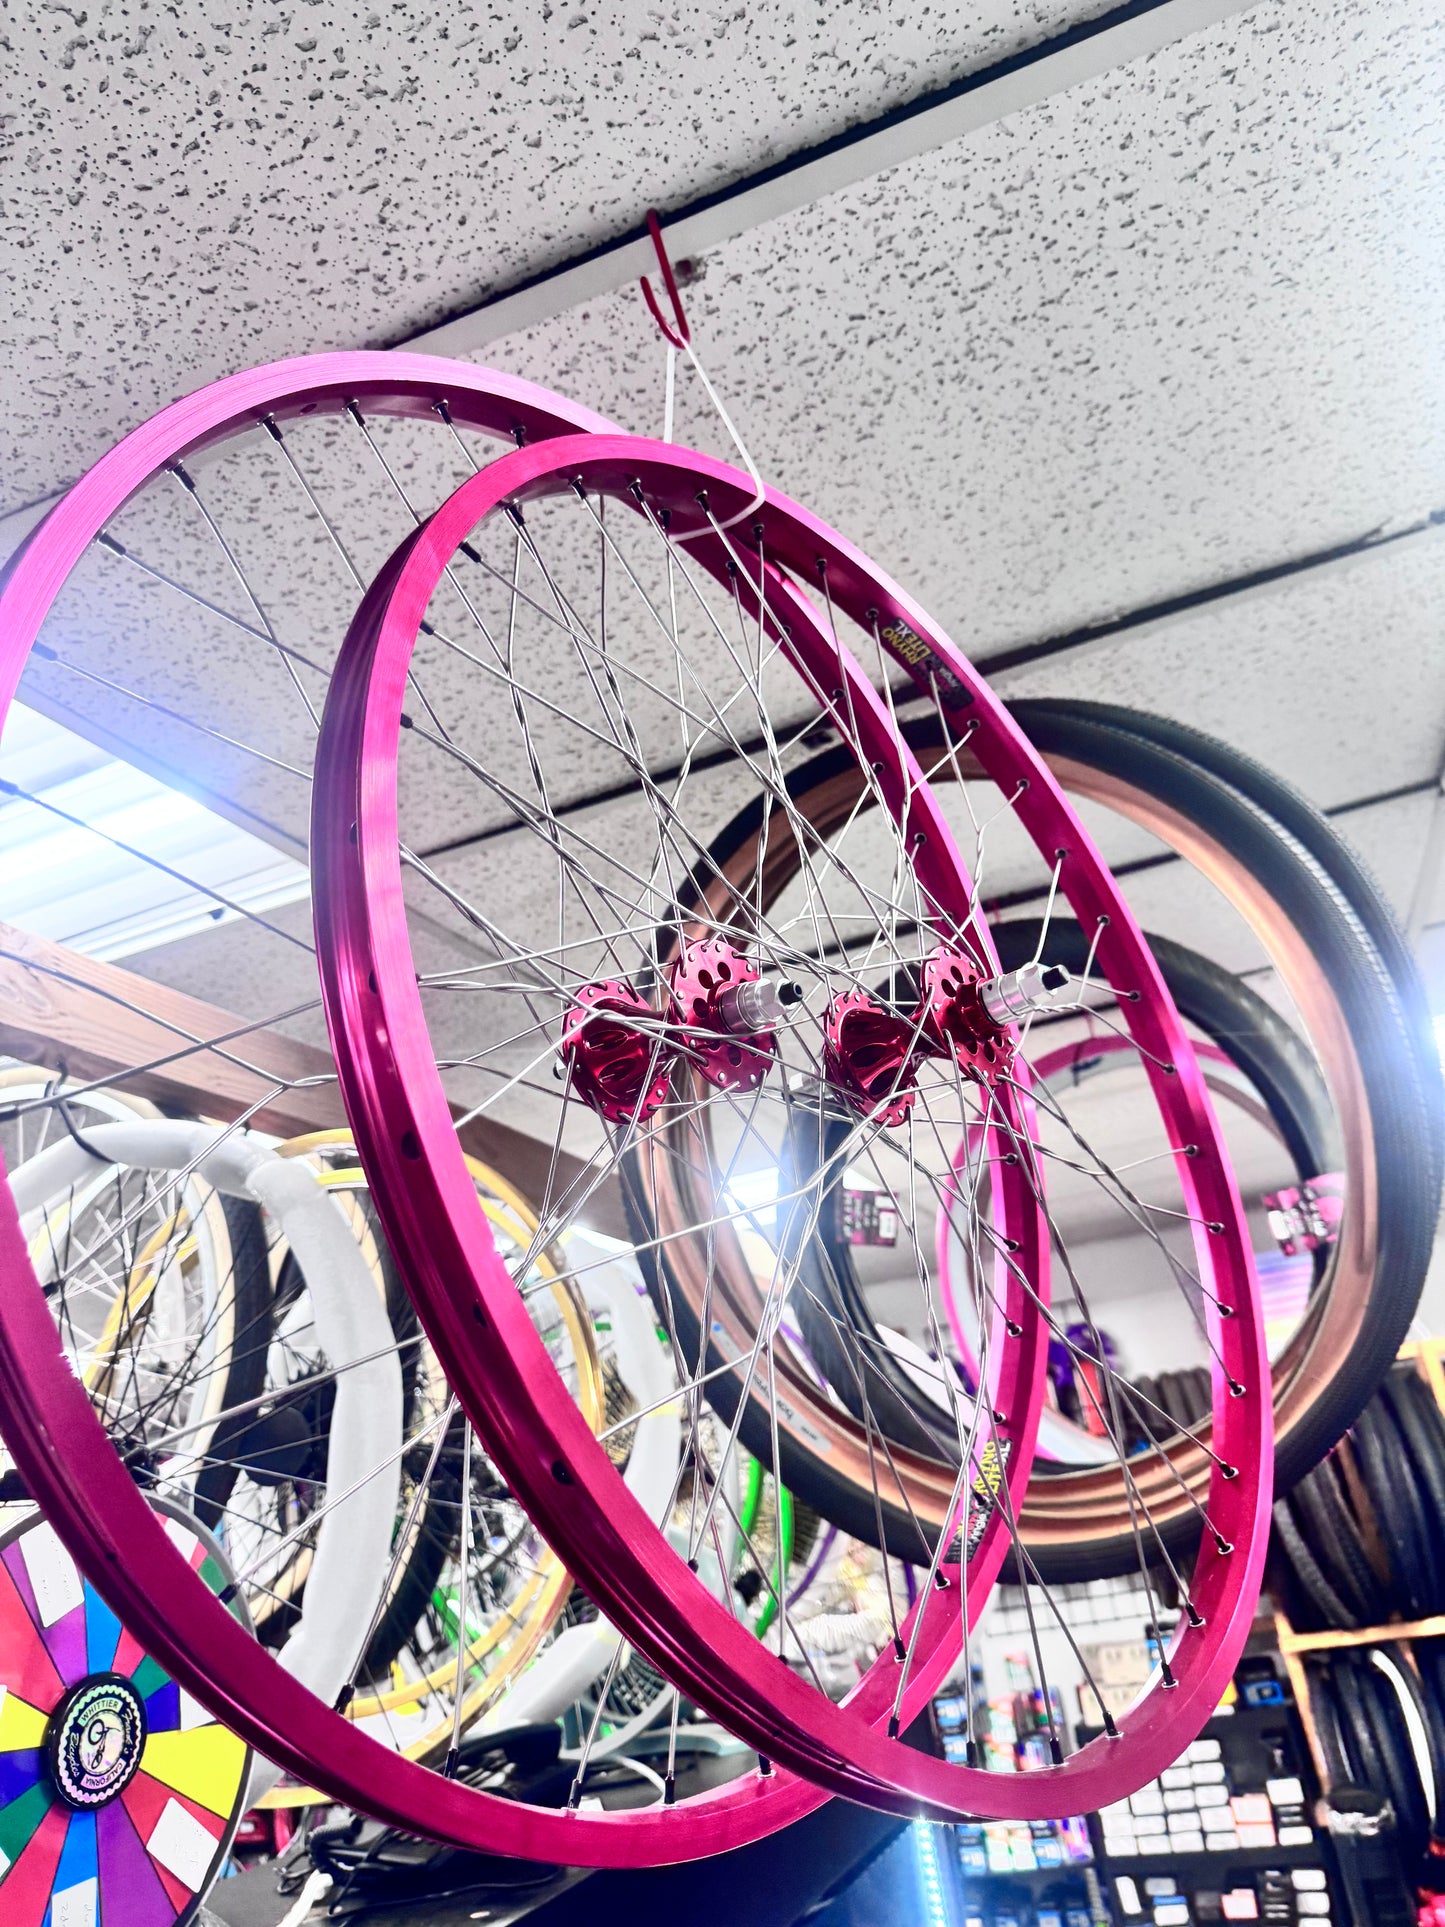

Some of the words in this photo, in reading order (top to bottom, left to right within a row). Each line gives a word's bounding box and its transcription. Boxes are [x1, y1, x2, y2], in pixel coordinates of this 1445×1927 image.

[882, 627, 922, 665] RHYNO
[81, 1700, 119, 1722] WHITTIER
[85, 1762, 123, 1787] CALIFORNIA
